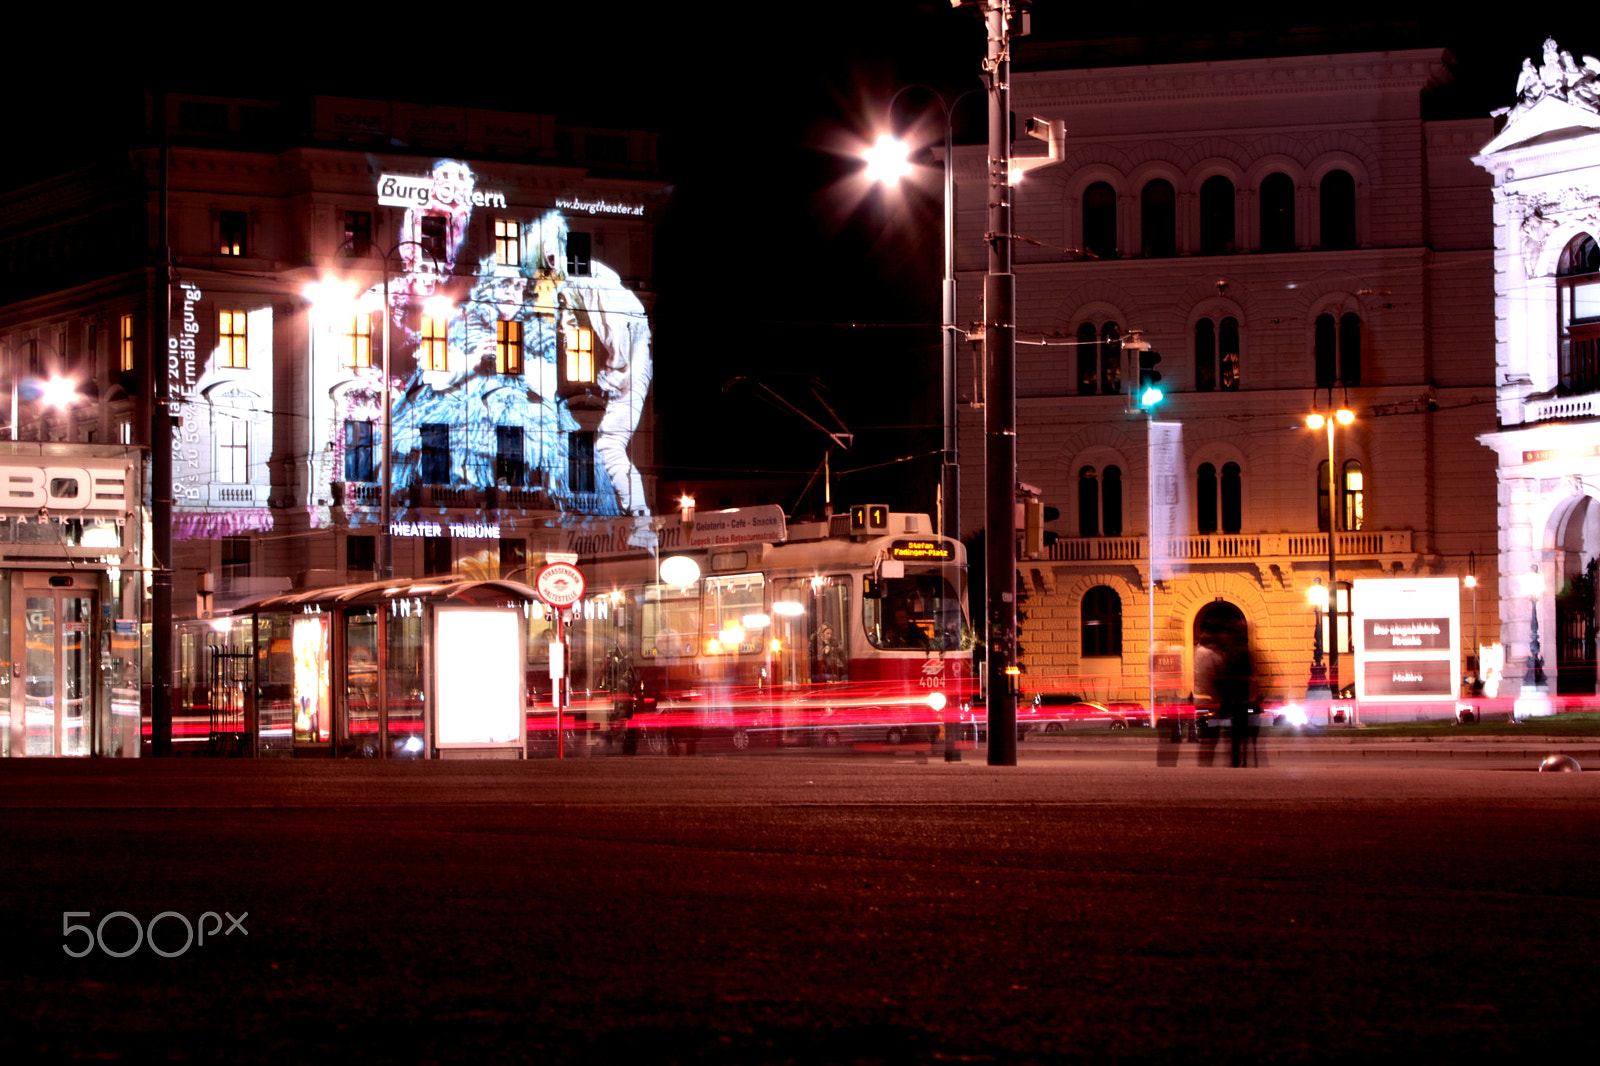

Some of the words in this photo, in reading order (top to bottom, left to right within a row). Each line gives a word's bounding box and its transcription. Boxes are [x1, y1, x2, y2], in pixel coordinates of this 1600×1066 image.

[381, 177, 429, 206] Burg
[0, 514, 126, 527] PARKING
[857, 510, 863, 525] 1
[874, 509, 880, 525] 1
[389, 521, 442, 537] THEATER
[617, 526, 627, 552] &
[919, 676, 946, 688] 4004
